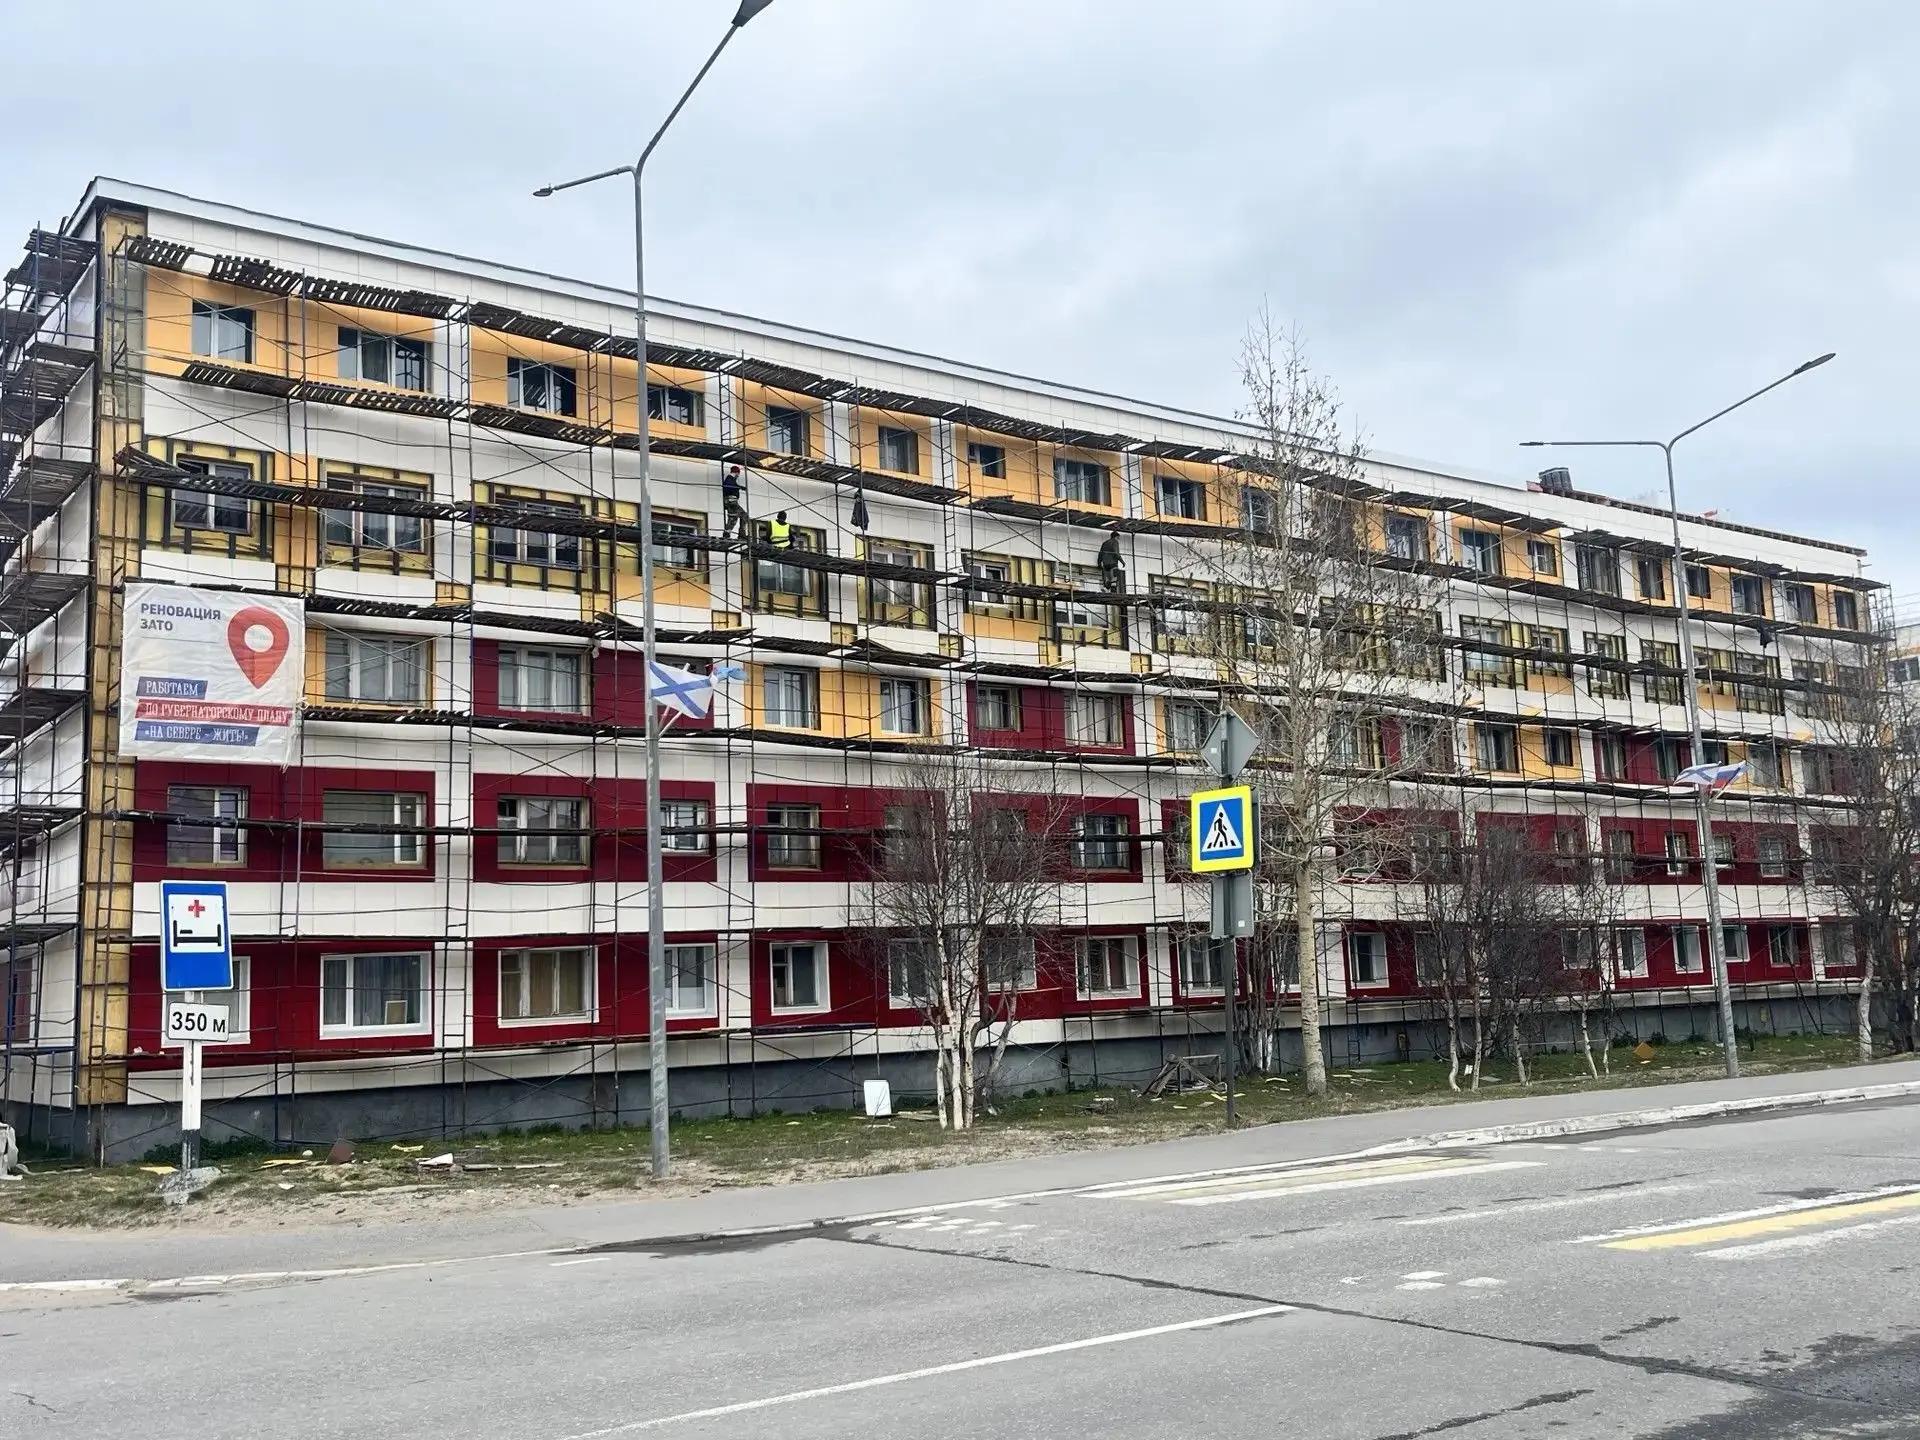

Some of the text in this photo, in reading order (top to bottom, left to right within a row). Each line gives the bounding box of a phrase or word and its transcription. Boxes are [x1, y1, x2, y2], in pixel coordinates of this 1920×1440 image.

[141, 603, 221, 620] РЕНОВАЦИЯ
[141, 618, 173, 631] ЗАТО
[146, 681, 198, 696] РАБОТАЕМ
[145, 702, 288, 723] ПО ГУБЕРНАТОРСКОМУ ПЛАНУ
[167, 727, 201, 740] СЕВЕРЕ
[172, 1011, 207, 1032] 350
